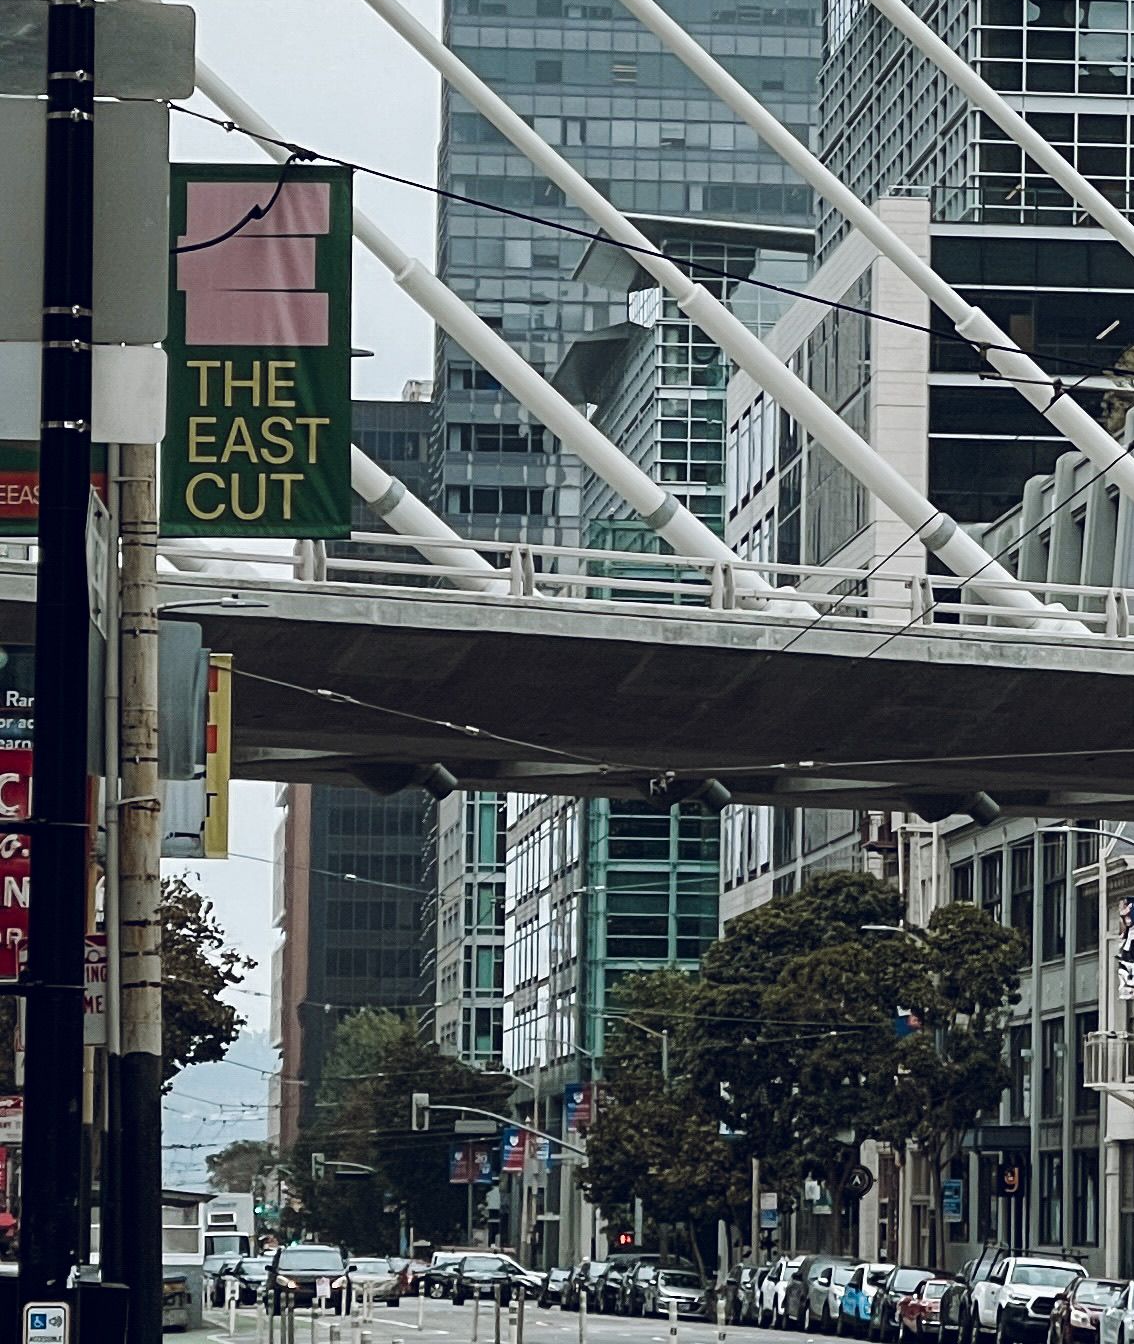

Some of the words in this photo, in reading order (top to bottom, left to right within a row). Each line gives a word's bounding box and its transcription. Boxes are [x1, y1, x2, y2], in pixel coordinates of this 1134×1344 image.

[187, 360, 296, 407] THE
[188, 417, 330, 464] EAST
[185, 473, 304, 520] CUT
